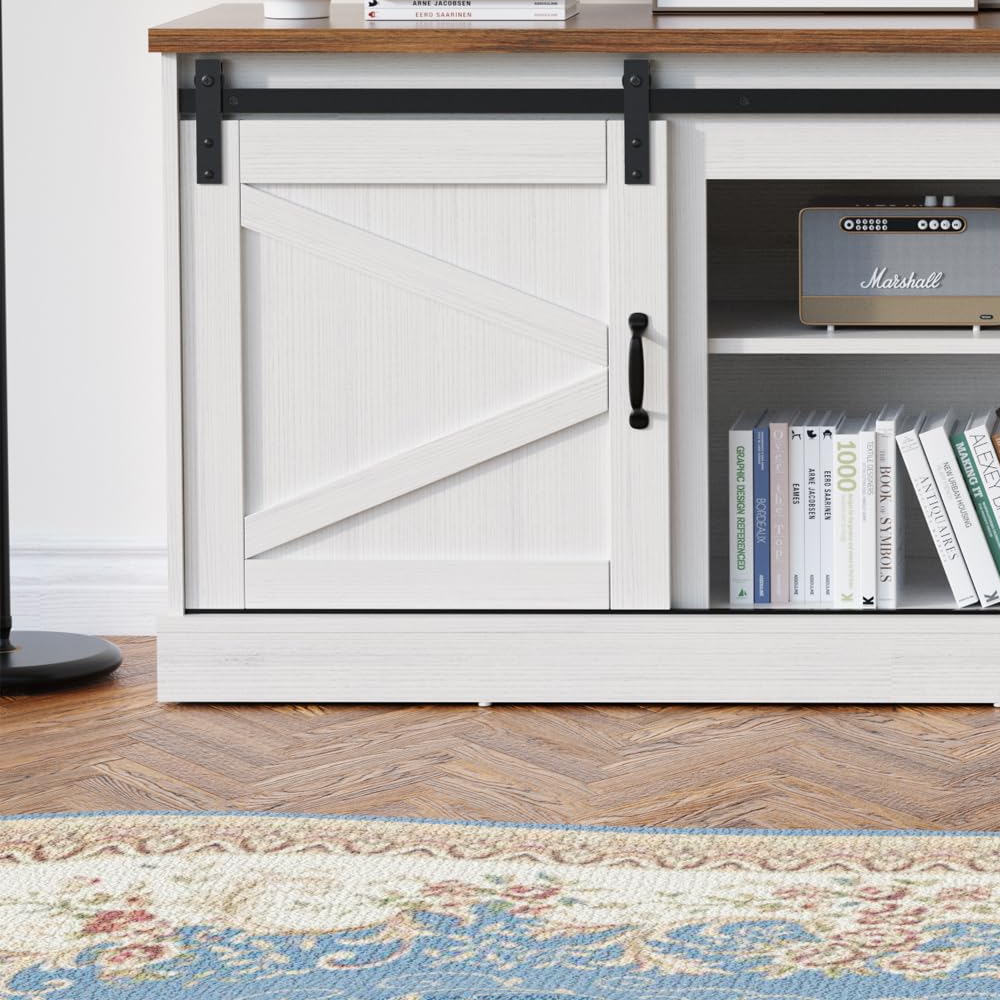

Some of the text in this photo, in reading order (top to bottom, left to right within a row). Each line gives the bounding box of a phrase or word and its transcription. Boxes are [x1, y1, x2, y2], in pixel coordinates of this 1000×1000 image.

[860, 267, 943, 289] Marshall
[837, 441, 857, 493] 1000
[866, 441, 874, 496] TEXTILE DESIGNERS
[880, 466, 892, 503] BOOK
[955, 441, 983, 499] MAKING IT
[736, 446, 746, 570] GRAPHIC DESIGN REFERENCED
[792, 483, 800, 505] EAMES
[808, 468, 816, 520] ARNE JACOBSEN
[824, 470, 832, 520] EERO SAARINEN
[919, 475, 958, 561] ANTIQUAIRES
[942, 461, 953, 477] NEW
[948, 476, 961, 500] URBAN
[956, 499, 972, 528] HOUSING
[756, 498, 767, 544] BORDEAUX
[880, 517, 892, 583] SYMBOLS
